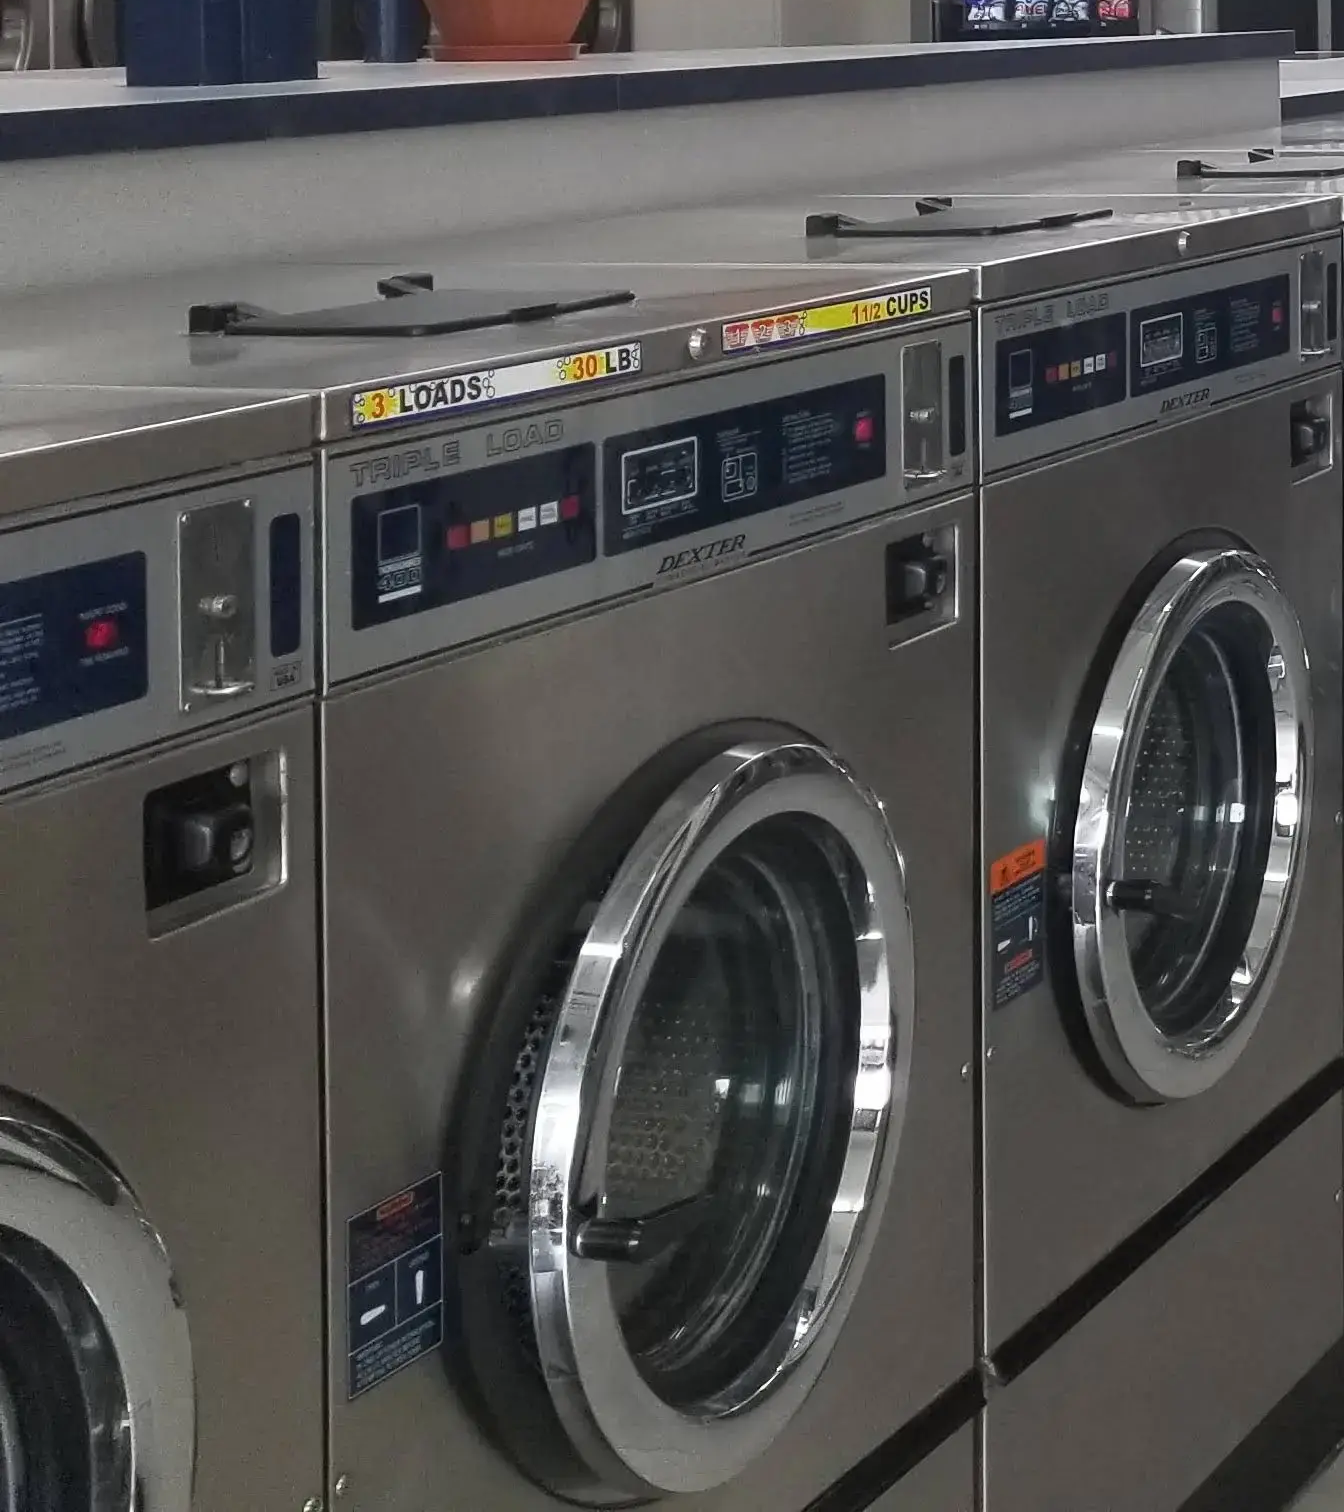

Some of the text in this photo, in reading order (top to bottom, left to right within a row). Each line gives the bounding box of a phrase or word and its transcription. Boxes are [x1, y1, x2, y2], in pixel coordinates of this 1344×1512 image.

[886, 290, 929, 317] CUPS
[371, 348, 632, 419] 3 LOADS 30 LB
[1159, 387, 1210, 415] DEXTER
[350, 419, 564, 488] TRIPLE LOAD
[656, 534, 746, 576] DEXTER
